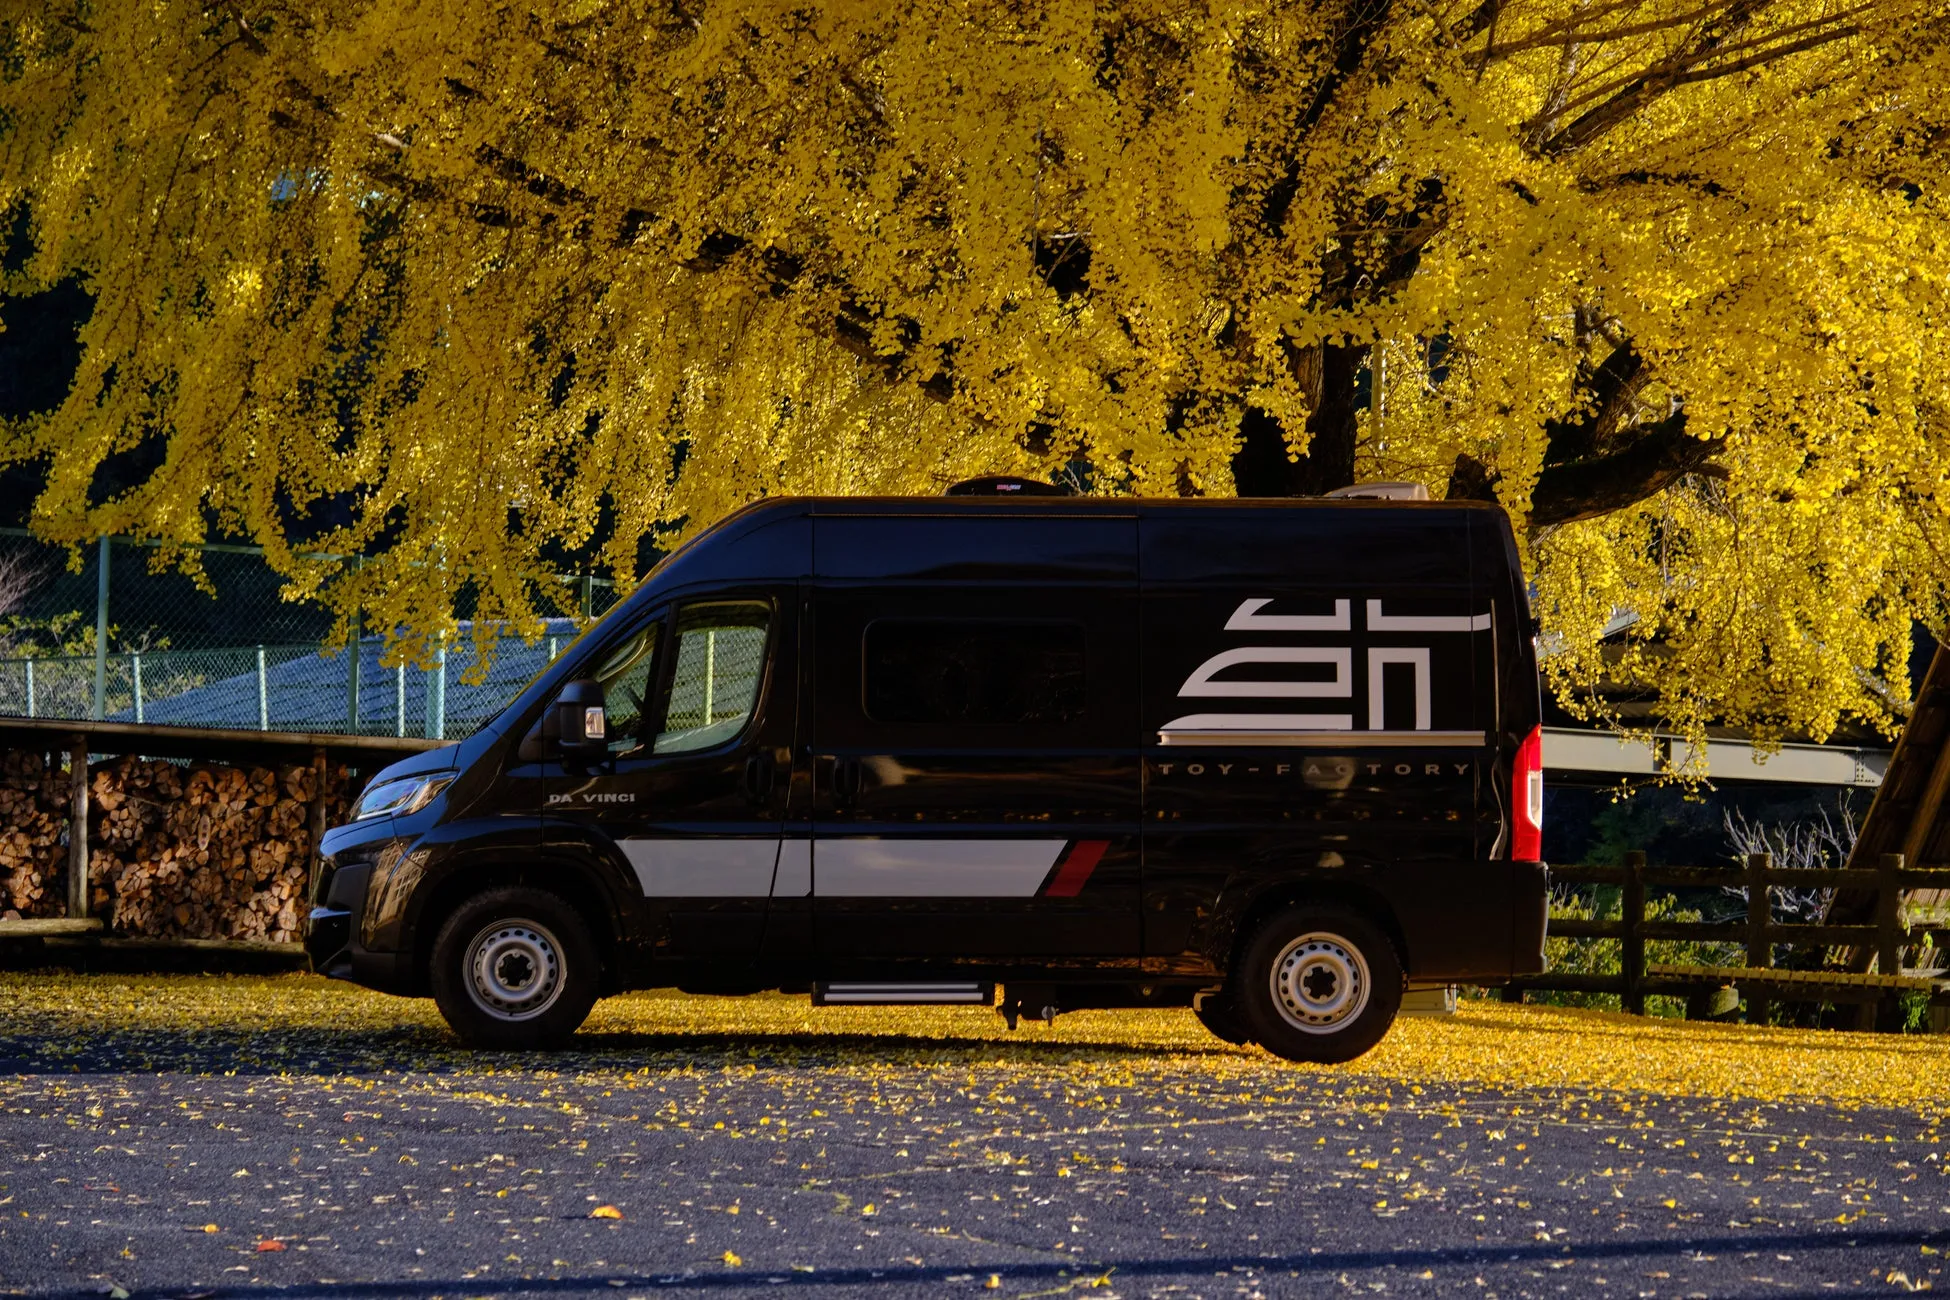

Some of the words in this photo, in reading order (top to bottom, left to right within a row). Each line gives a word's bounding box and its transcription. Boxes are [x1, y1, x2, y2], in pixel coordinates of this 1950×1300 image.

[1158, 763, 1469, 775] TOY-FACTORY
[549, 794, 573, 803] DA
[582, 793, 635, 803] VINCI
